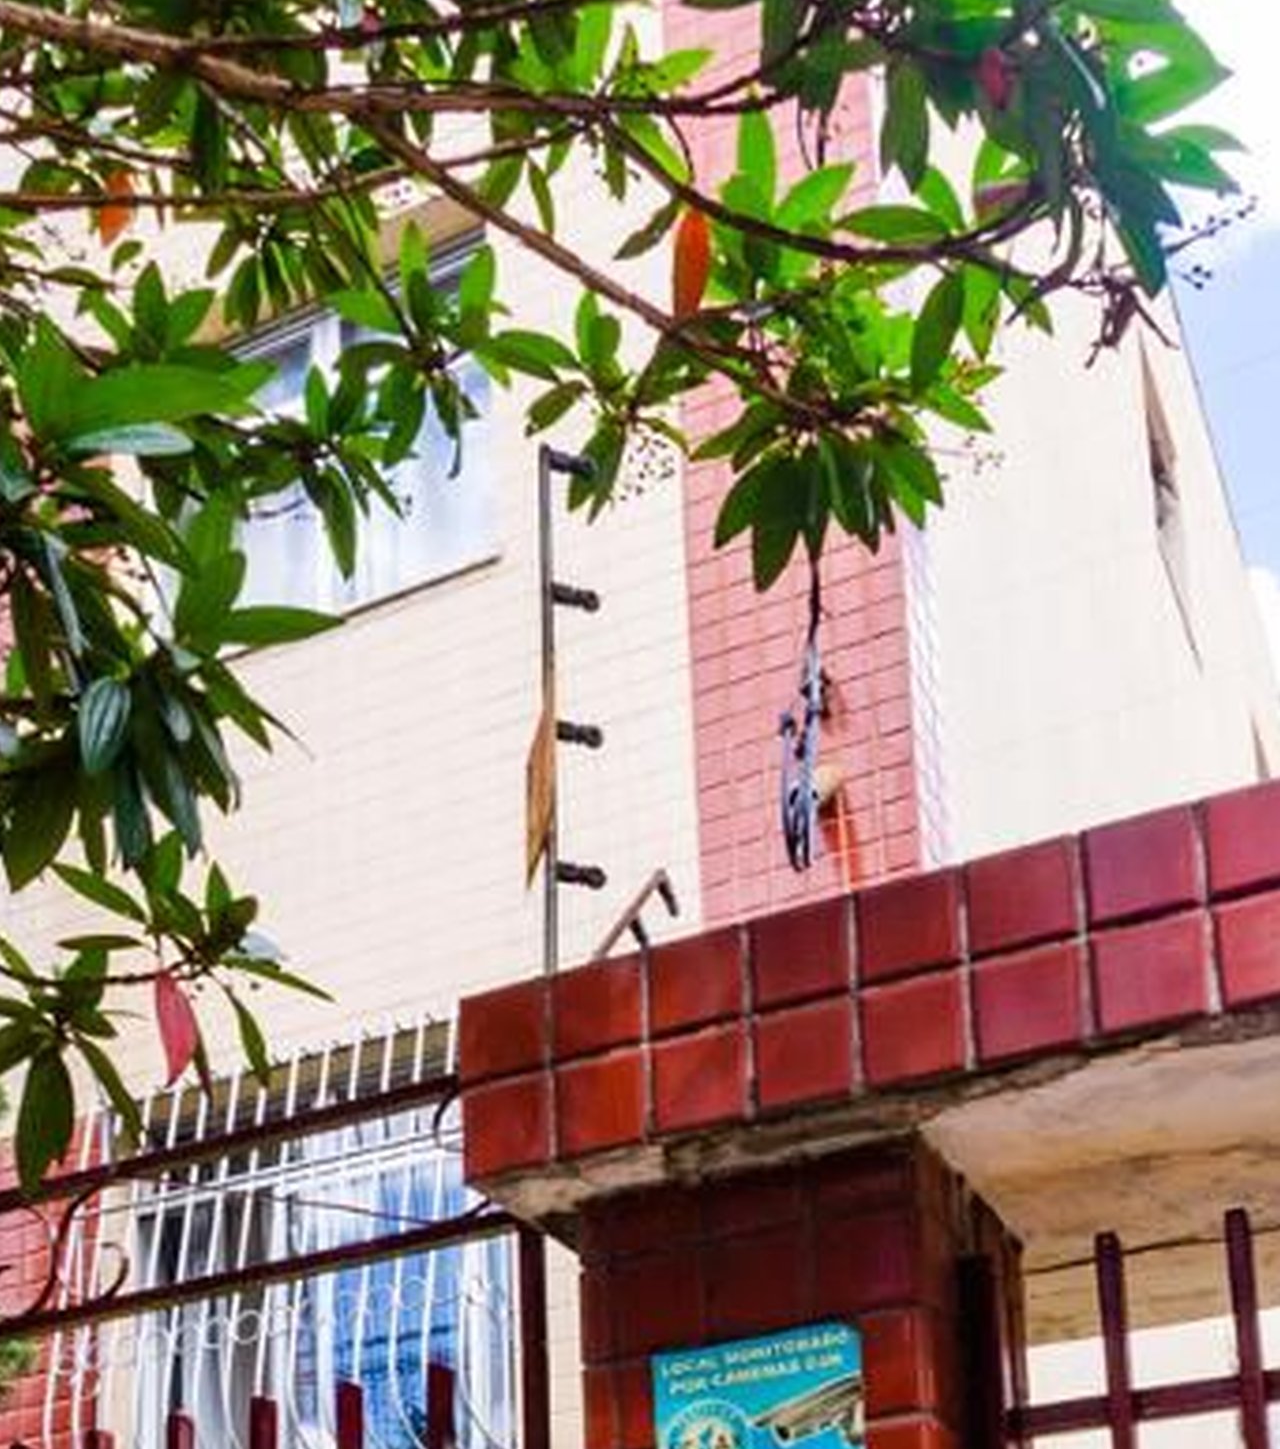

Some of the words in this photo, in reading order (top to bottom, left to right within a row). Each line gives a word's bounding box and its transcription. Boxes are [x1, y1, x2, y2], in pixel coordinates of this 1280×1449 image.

[661, 1358, 719, 1379] LOCAL
[724, 1330, 849, 1365] MONITORADO
[669, 1376, 709, 1395] POR
